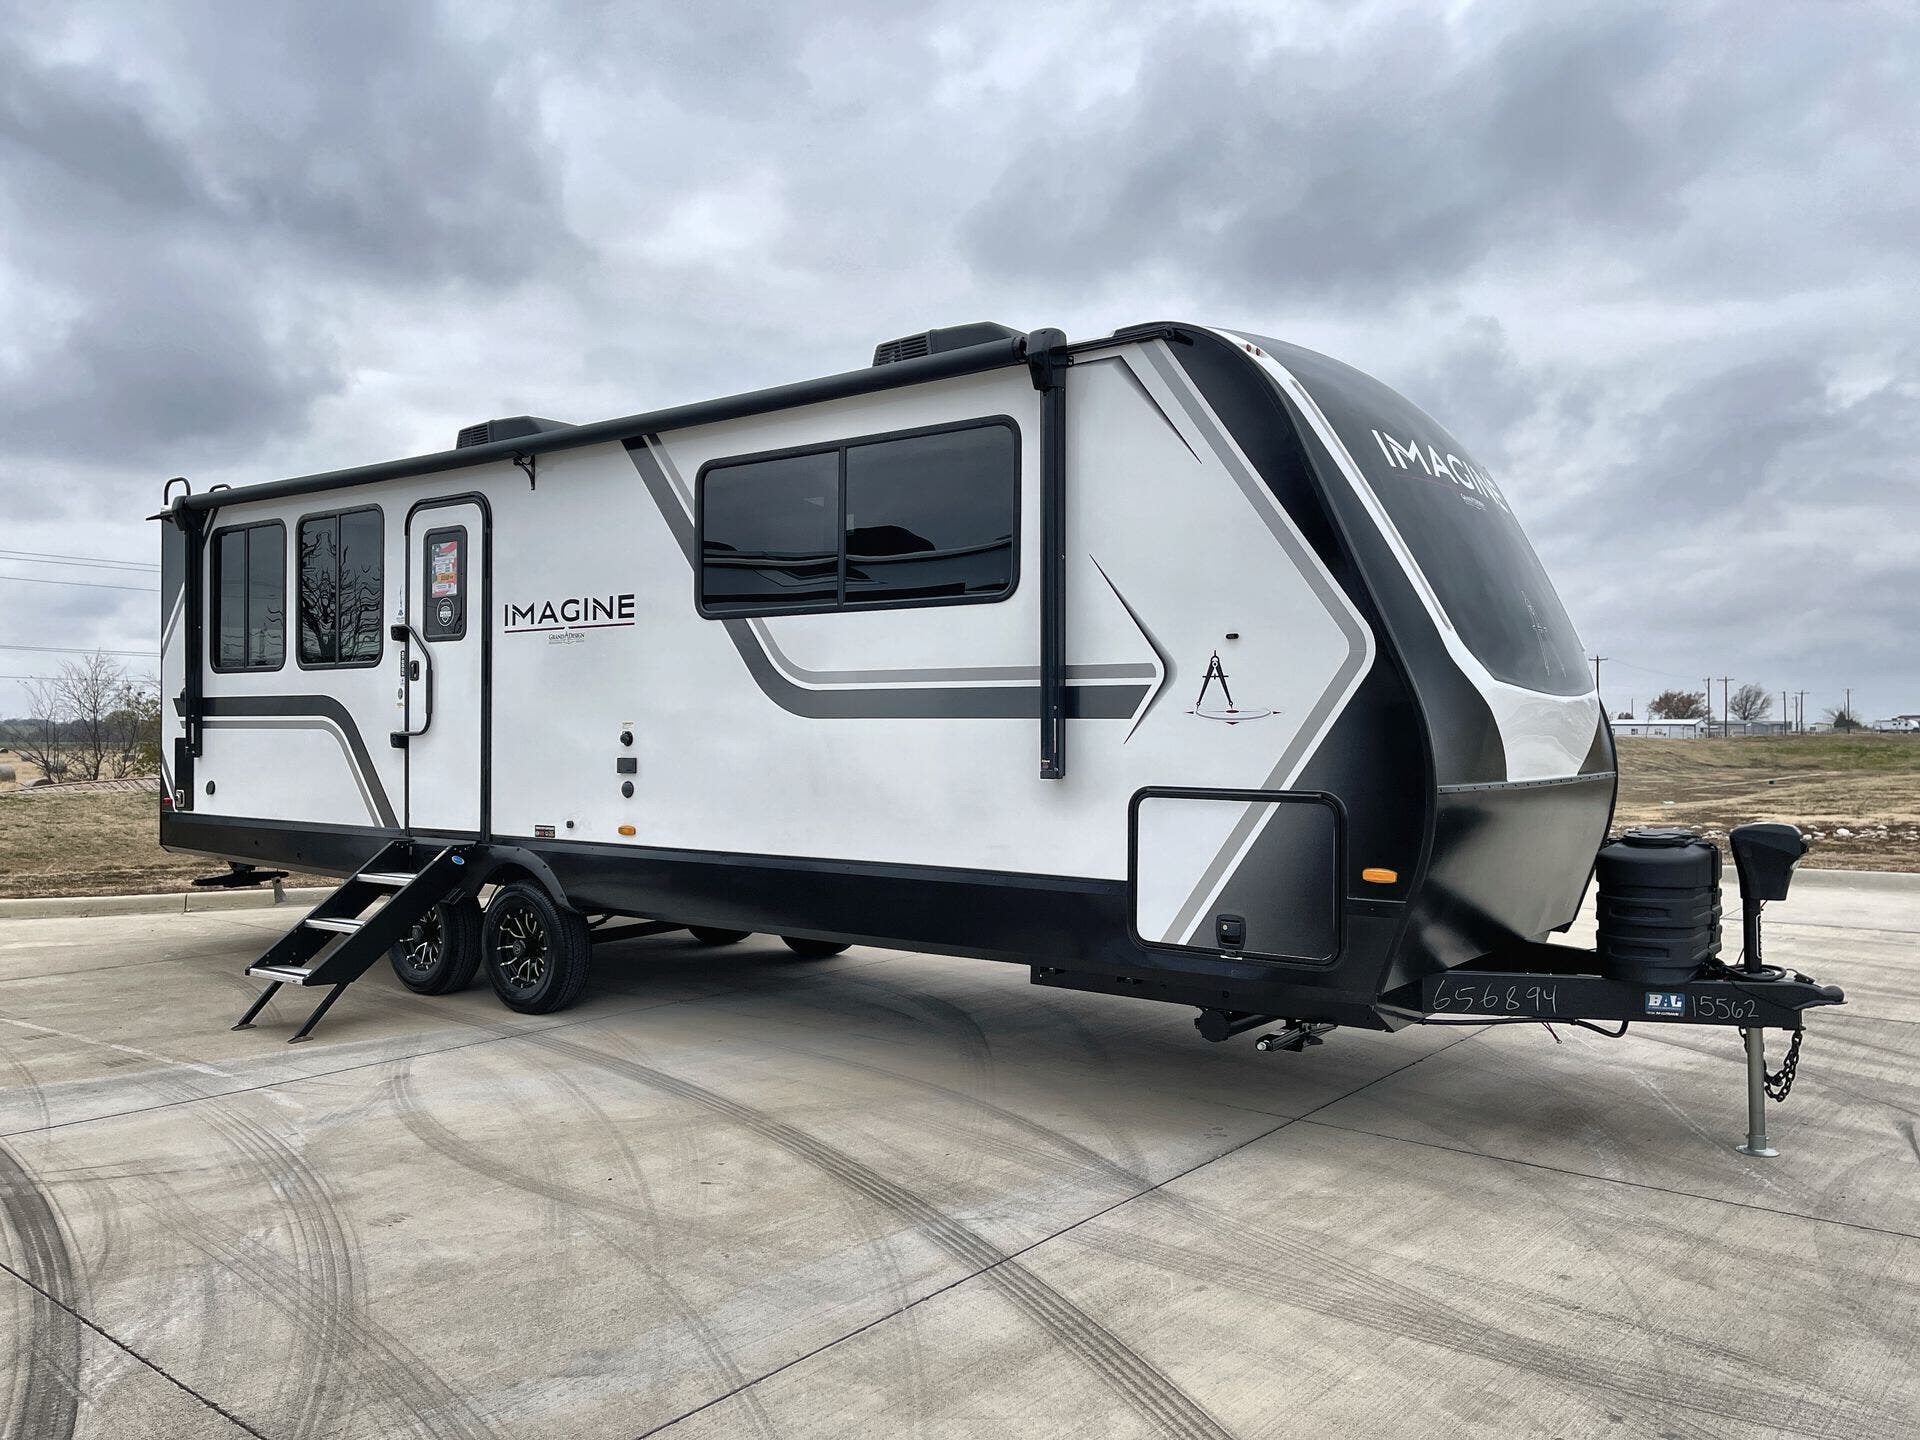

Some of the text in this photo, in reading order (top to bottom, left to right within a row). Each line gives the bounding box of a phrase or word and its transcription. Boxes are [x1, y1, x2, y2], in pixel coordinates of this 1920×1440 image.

[1371, 429, 1510, 513] IMAGINE
[504, 594, 635, 626] IMAGINE
[1432, 980, 1557, 1013] 656894
[1692, 995, 1759, 1019] 15562
